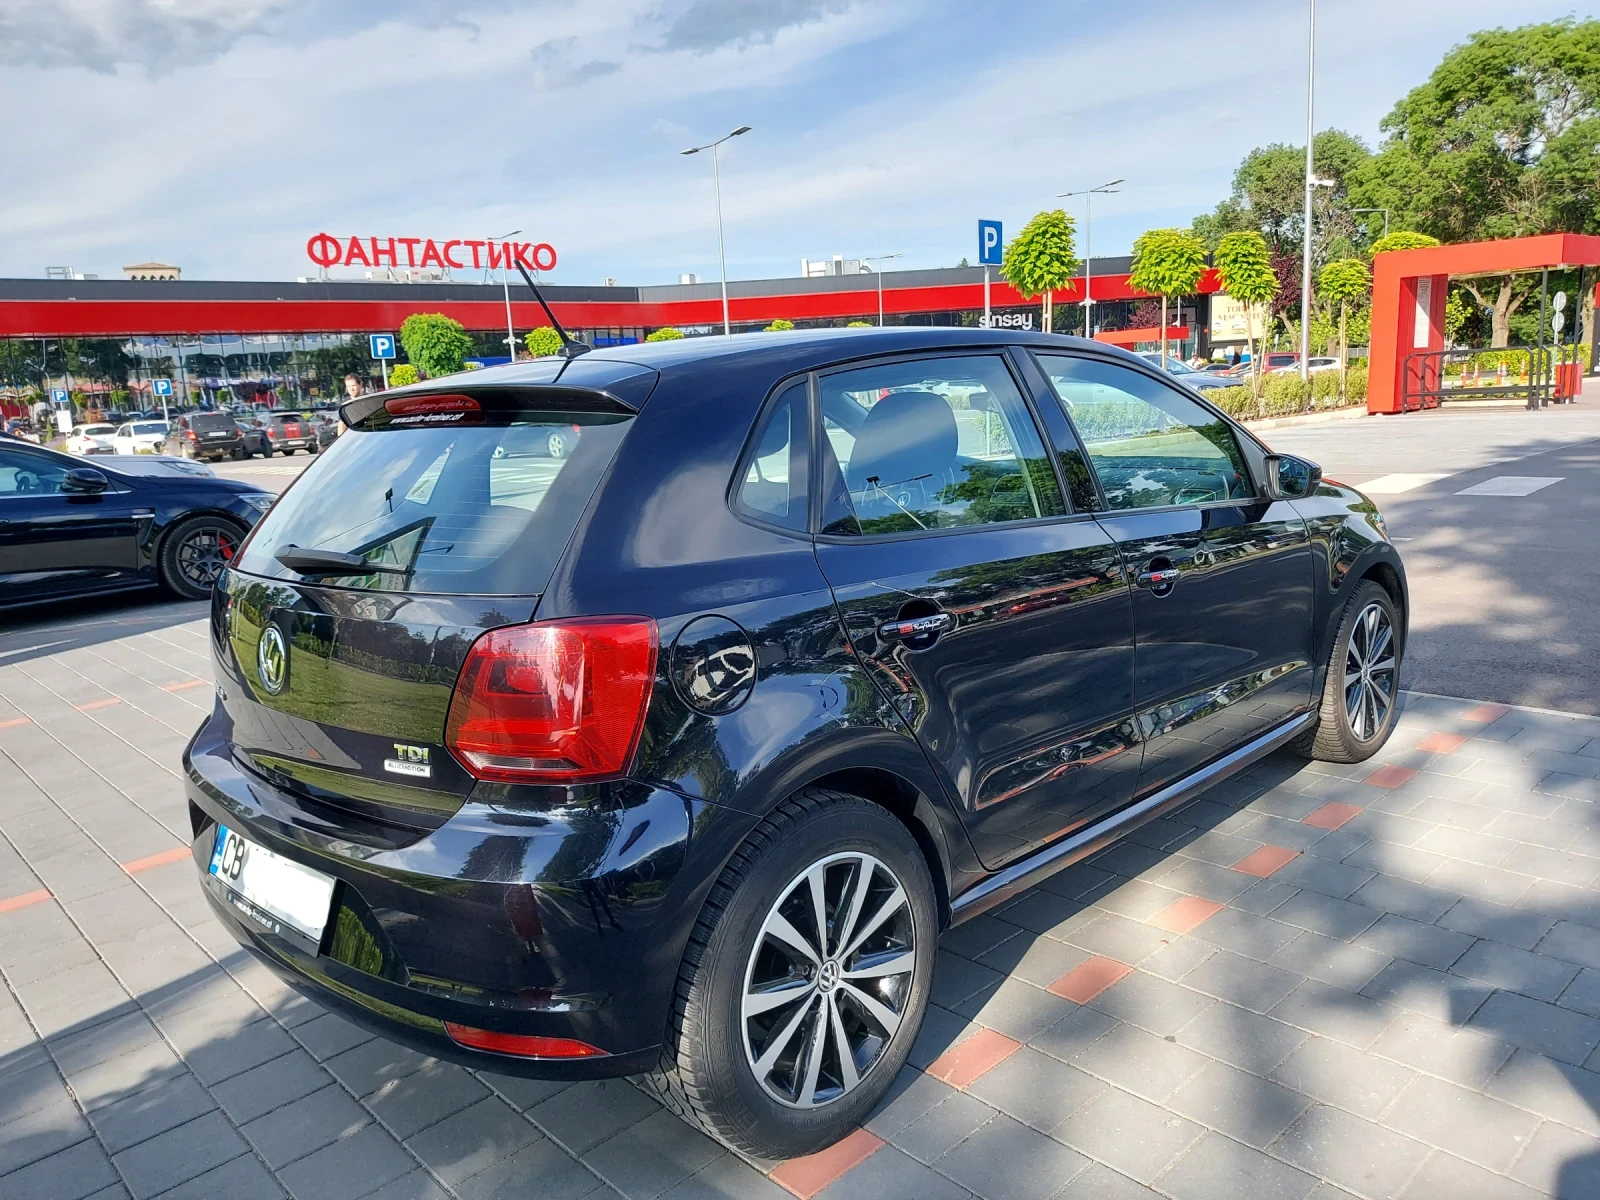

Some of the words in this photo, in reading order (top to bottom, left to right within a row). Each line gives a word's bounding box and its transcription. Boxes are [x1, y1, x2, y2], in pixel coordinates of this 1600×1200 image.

[307, 232, 557, 272] ФАНТАСТИКО
[984, 226, 998, 260] P
[376, 338, 390, 356] P
[55, 391, 65, 401] P
[157, 381, 168, 394] P
[393, 743, 430, 763] TDI
